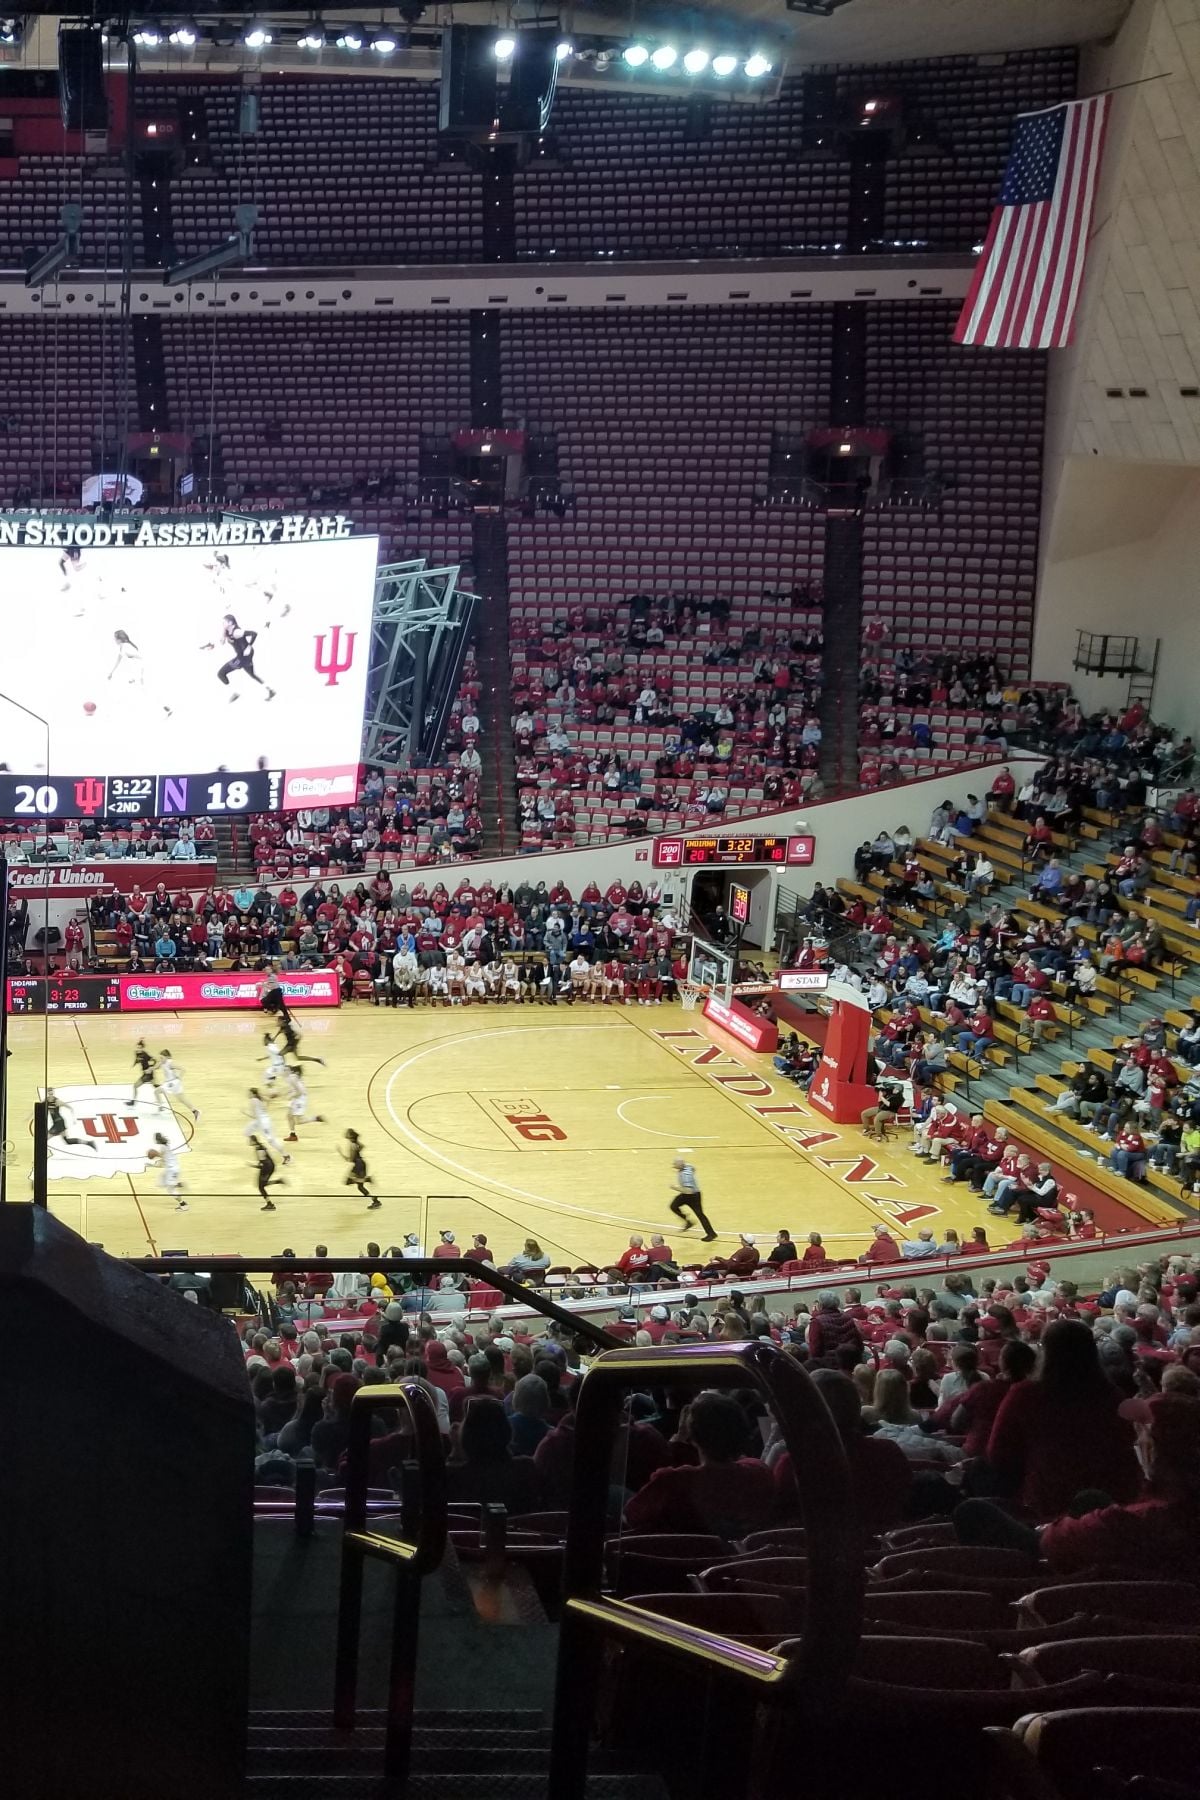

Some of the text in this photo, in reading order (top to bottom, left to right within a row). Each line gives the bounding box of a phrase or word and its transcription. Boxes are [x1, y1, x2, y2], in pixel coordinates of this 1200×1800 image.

[24, 519, 129, 546] SKJODT
[134, 519, 280, 546] ASSEMBLY
[280, 515, 354, 542] HALL
[112, 779, 152, 795] 3:22
[14, 785, 58, 813] 20
[163, 777, 188, 812] N
[207, 781, 249, 810] 18
[662, 845, 678, 854] 200
[686, 840, 717, 848] INDIANA
[727, 840, 752, 851] 3:22
[690, 850, 705, 861] 20
[771, 848, 782, 859] 18
[9, 867, 104, 885] Credit Union
[795, 976, 820, 985] STAR
[14, 987, 26, 997] 20
[51, 989, 80, 1001] 3:23
[129, 985, 161, 999] O'Reilly
[203, 984, 234, 998] O'Reilly
[650, 1028, 942, 1228] INDIANA
